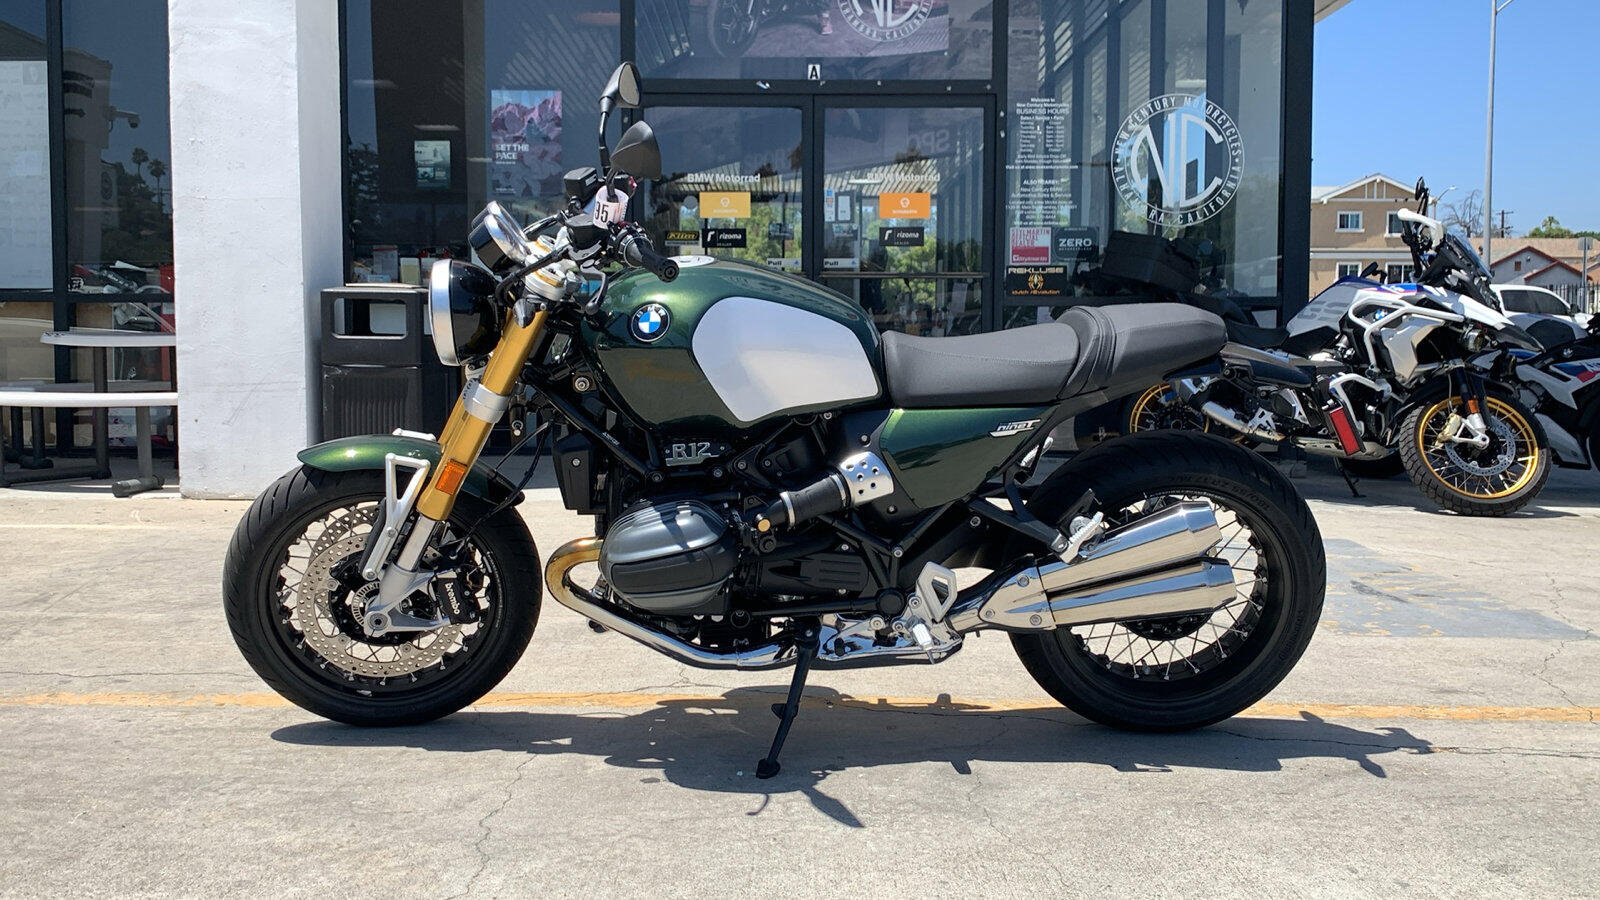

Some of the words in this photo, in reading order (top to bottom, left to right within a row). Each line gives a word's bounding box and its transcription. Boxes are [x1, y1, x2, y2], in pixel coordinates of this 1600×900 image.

[809, 65, 819, 79] A
[1128, 96, 1176, 128] CENTURY
[1184, 96, 1243, 156] MOORCYCLES
[495, 143, 513, 151] SET
[513, 143, 530, 151] THE
[495, 152, 518, 160] PACE
[687, 173, 714, 183] BMW
[715, 173, 761, 183] Motorrad
[1178, 166, 1242, 224] CALIFORNIA
[1058, 238, 1093, 247] ZERO
[444, 582, 460, 615] brembo
